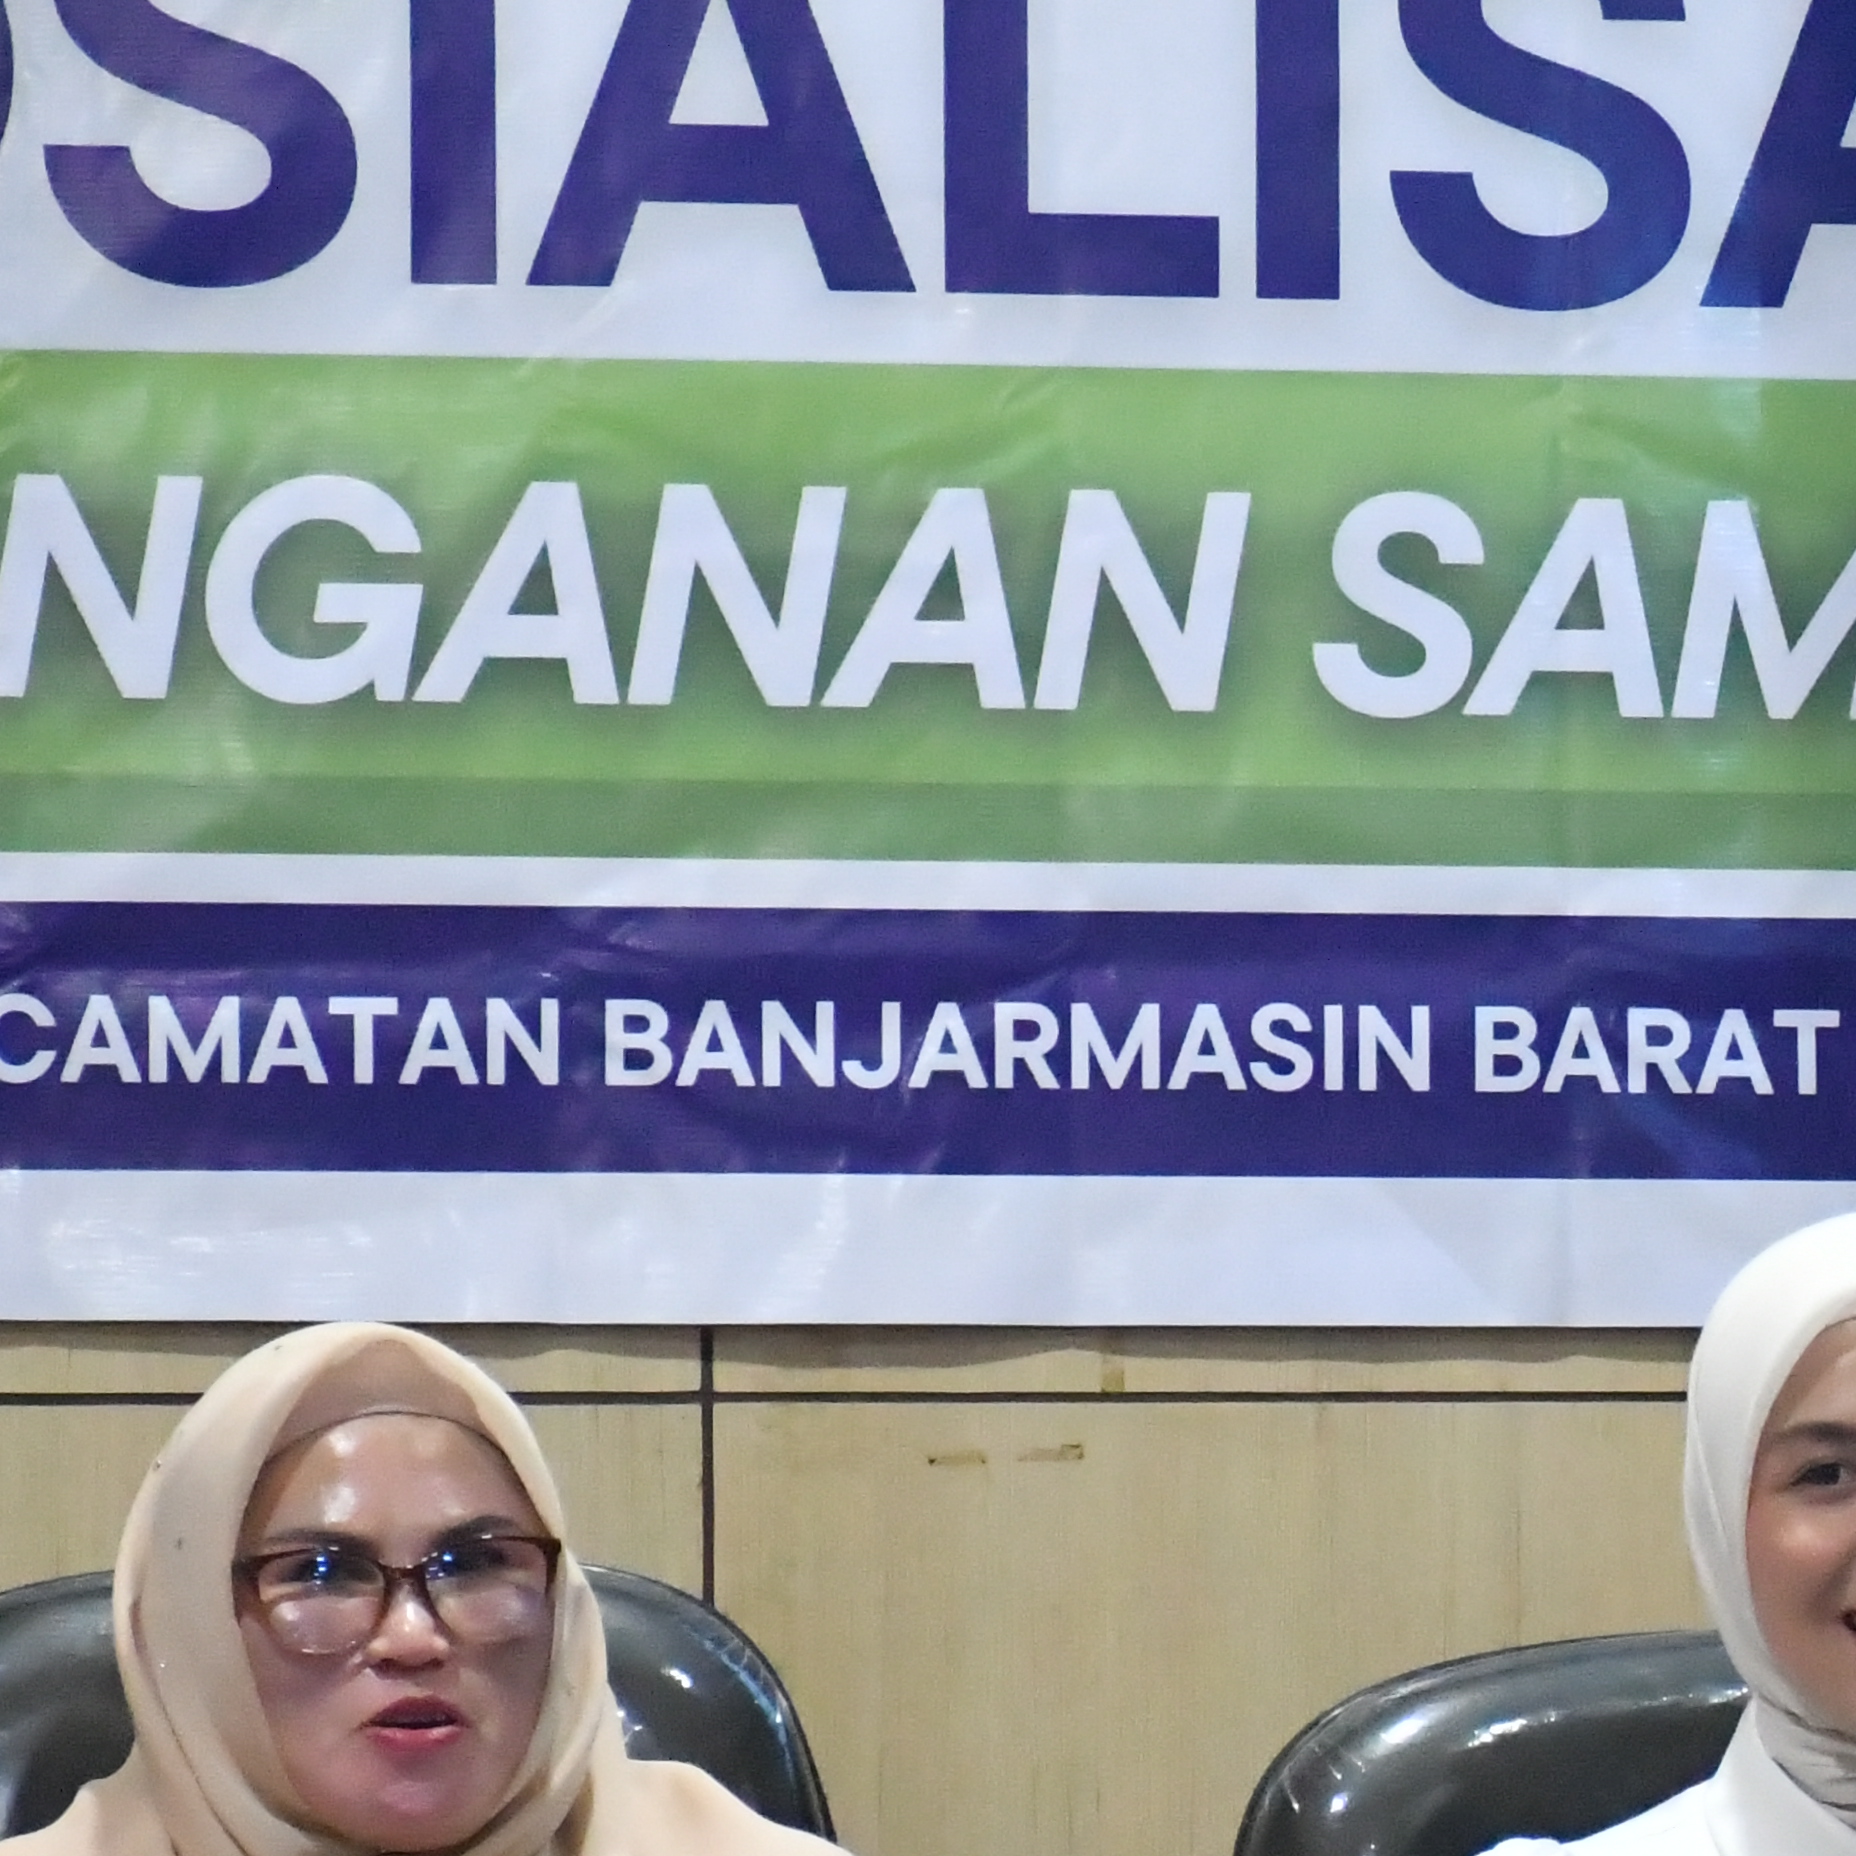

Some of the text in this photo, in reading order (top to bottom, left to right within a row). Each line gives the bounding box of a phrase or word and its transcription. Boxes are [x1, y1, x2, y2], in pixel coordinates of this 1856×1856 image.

[0, 473, 1252, 712] NGANAN
[0, 991, 1842, 1097] CAMATAN BANJARMASIN BARAT
